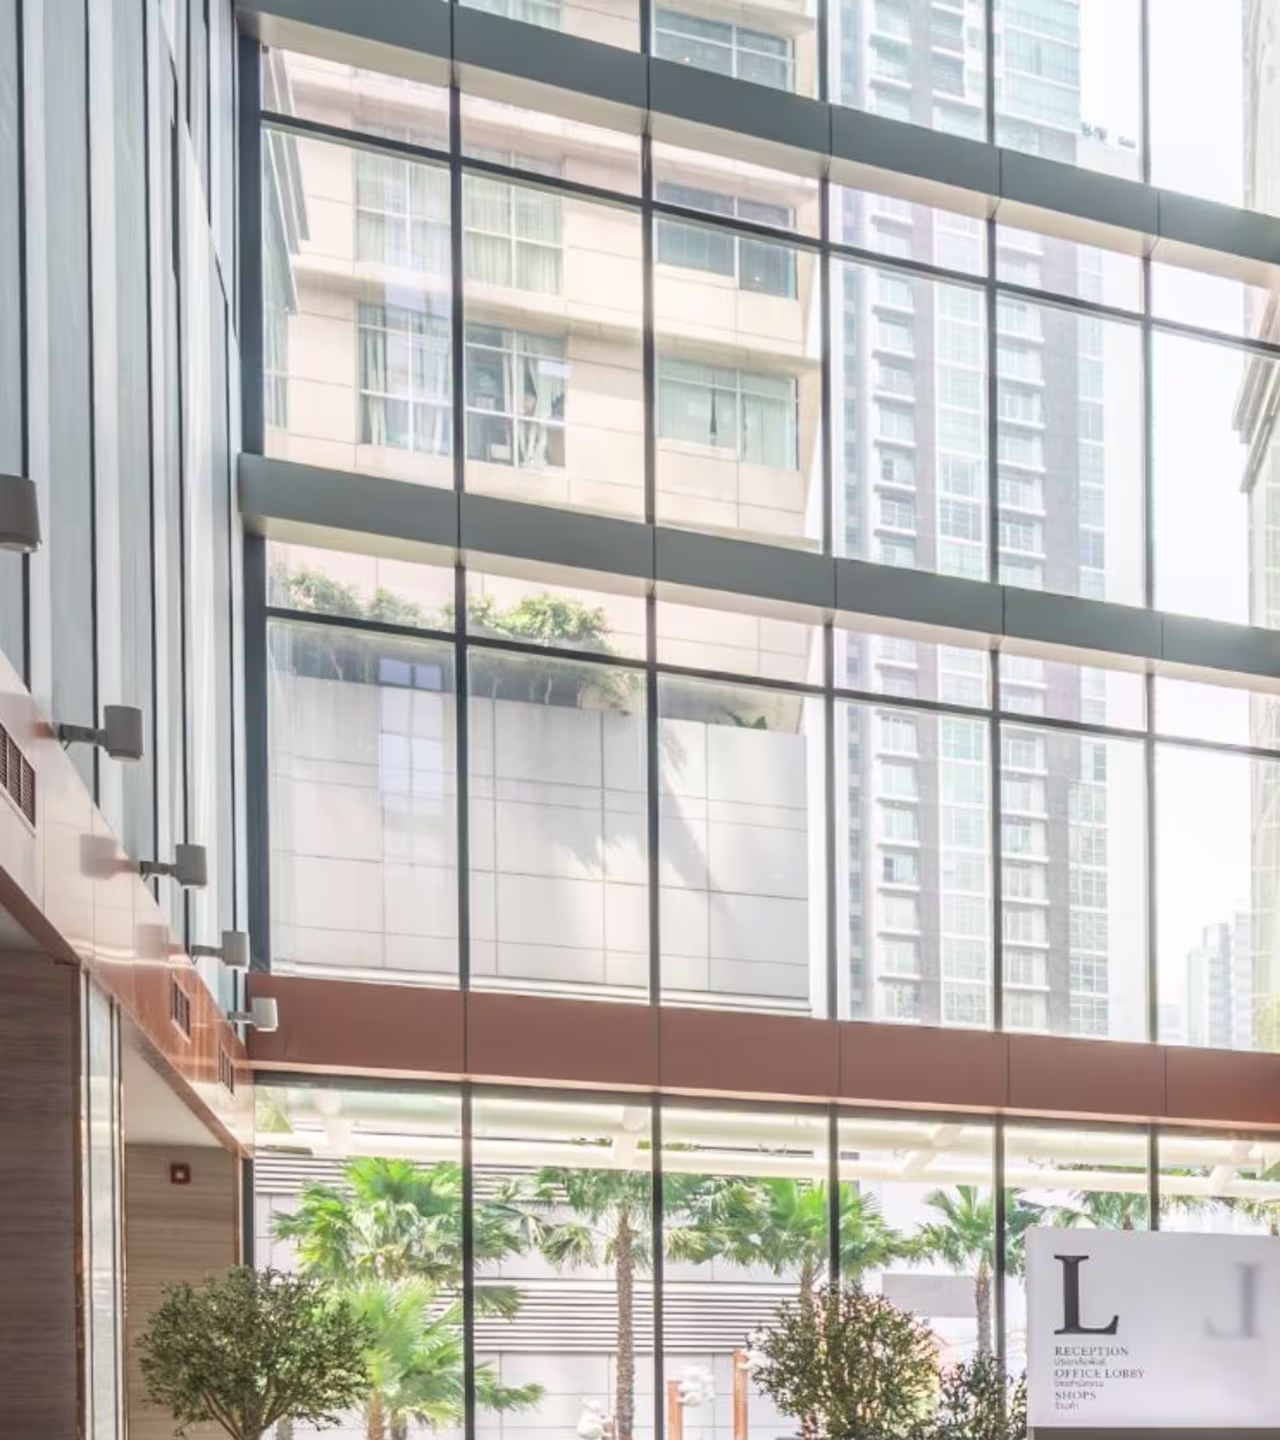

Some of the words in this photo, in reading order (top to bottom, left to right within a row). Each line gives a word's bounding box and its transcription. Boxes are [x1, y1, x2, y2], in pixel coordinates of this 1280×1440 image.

[1053, 1254, 1119, 1335] L
[1054, 1346, 1129, 1357] RECEPTION
[1054, 1368, 1102, 1379] OFFICE
[1104, 1368, 1145, 1379] LOBBY
[1054, 1391, 1097, 1401] SHOPS
